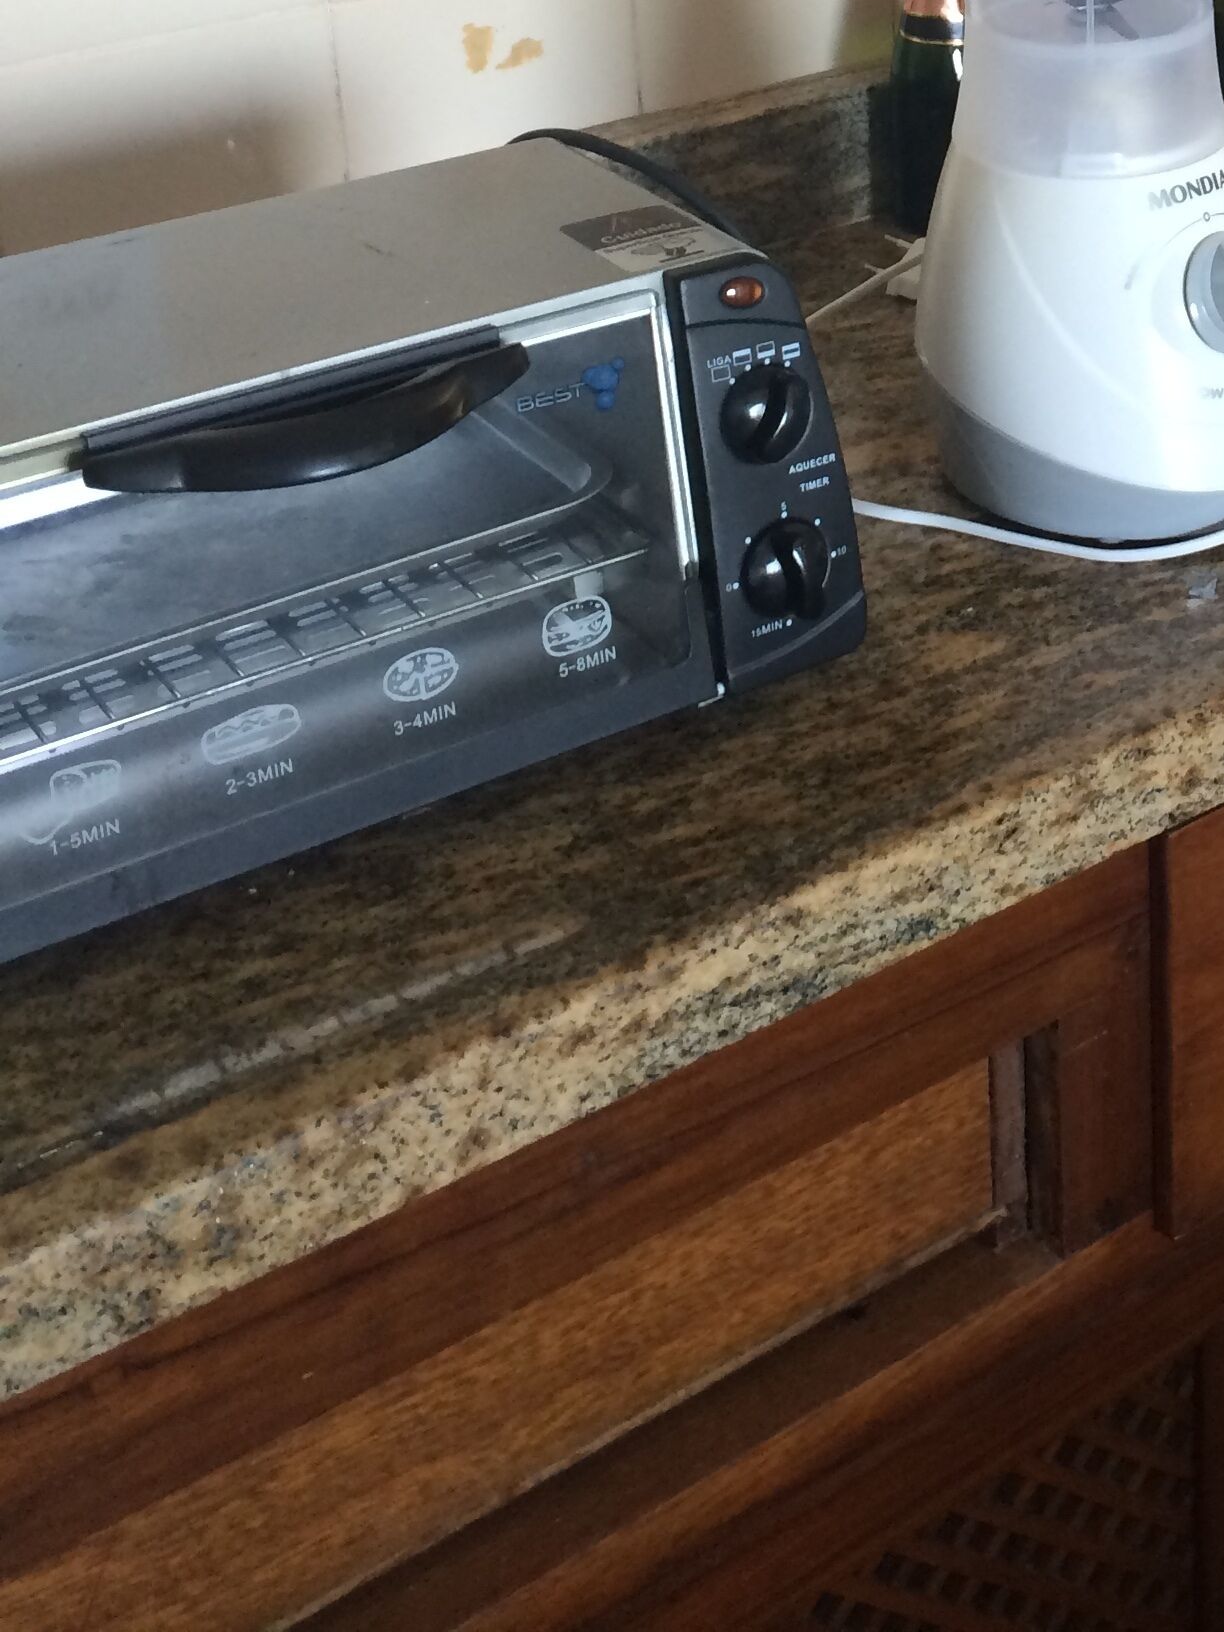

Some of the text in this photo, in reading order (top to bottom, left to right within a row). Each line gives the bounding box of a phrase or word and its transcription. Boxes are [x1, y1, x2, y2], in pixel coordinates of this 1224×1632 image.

[706, 355, 732, 369] LIGA
[517, 382, 585, 413] BEST
[788, 452, 836, 475] AQUECER
[799, 476, 830, 493] TIMER
[558, 645, 617, 679] 5-8MIN
[393, 700, 457, 737] 3-4MIN
[225, 757, 295, 796] 2-3MIN
[50, 818, 121, 857] 1-5MIN
